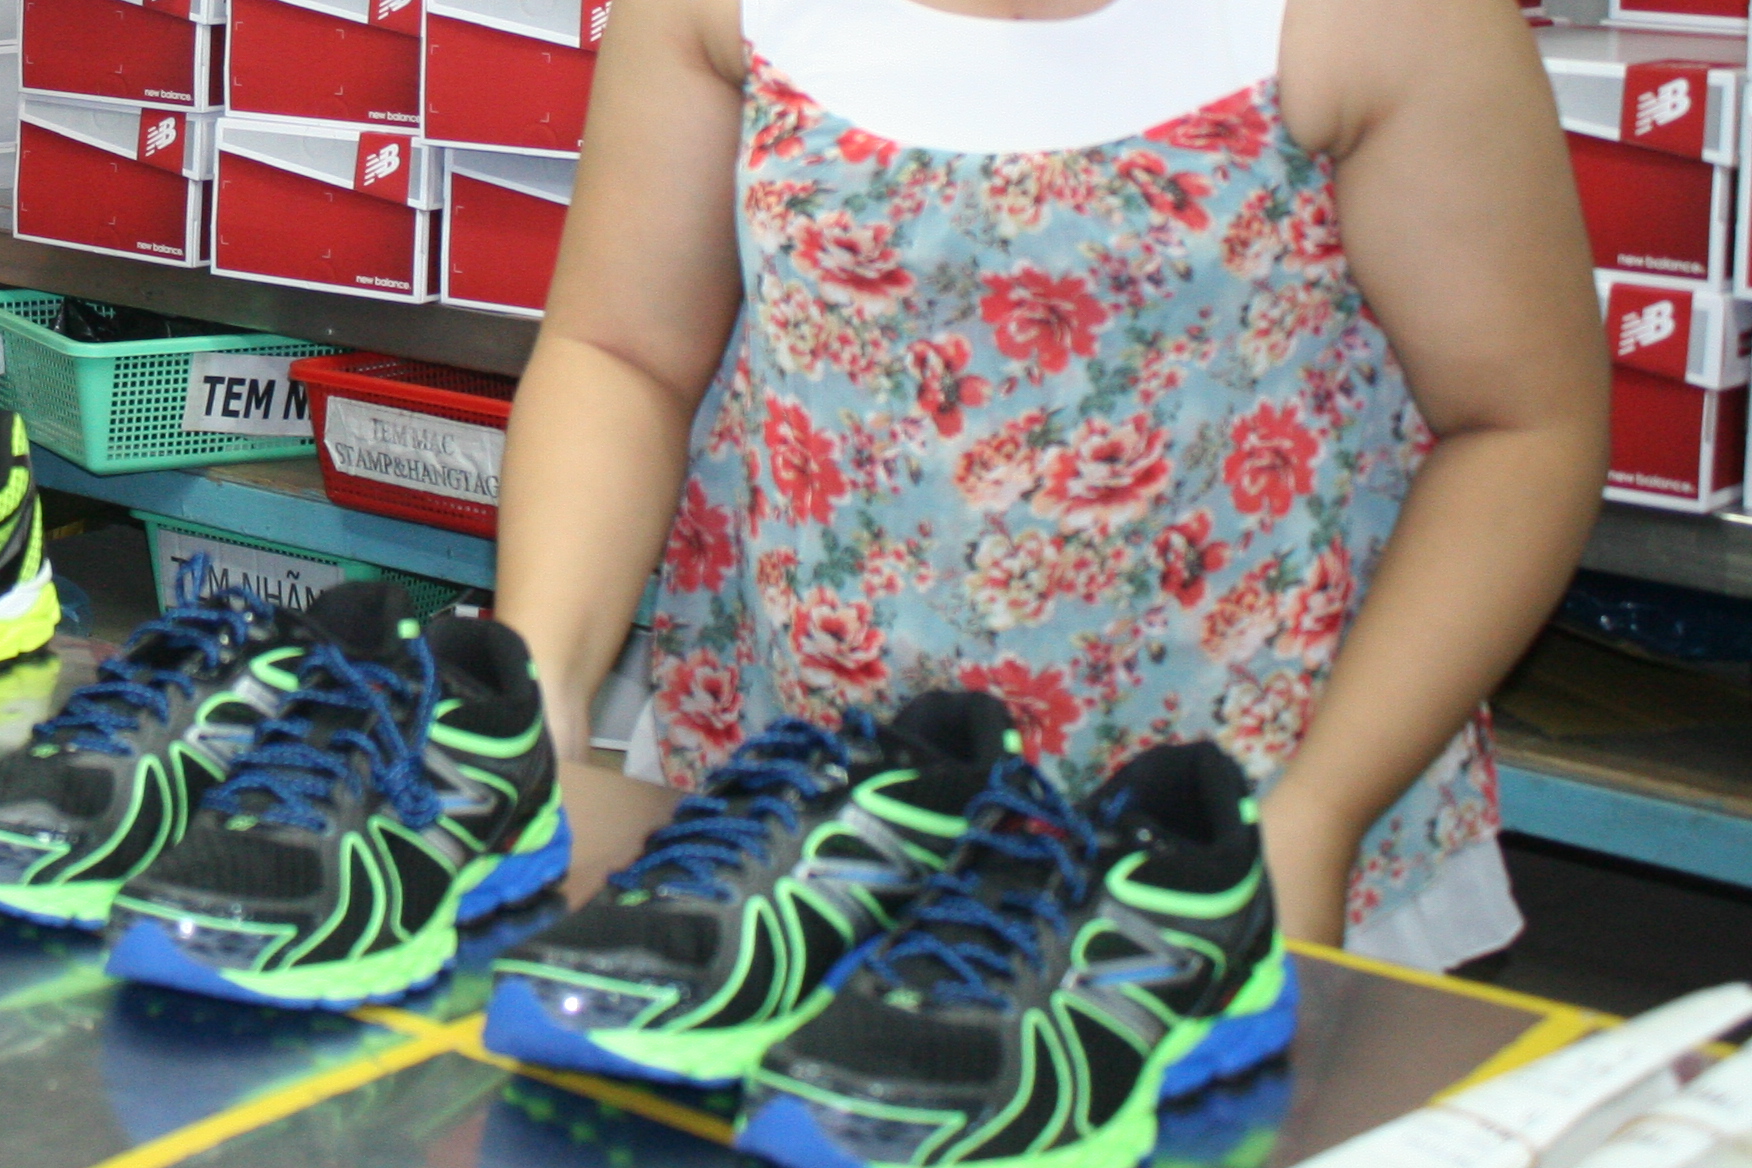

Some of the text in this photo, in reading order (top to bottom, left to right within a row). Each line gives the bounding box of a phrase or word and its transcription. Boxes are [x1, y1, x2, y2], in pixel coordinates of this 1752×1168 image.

[144, 89, 159, 97] new
[1635, 78, 1691, 135] NB
[368, 111, 386, 119] new
[146, 117, 176, 156] NB
[364, 144, 400, 185] NB
[136, 242, 152, 250] new
[356, 276, 373, 284] new
[1619, 300, 1675, 355] NB
[203, 375, 276, 420] TEM
